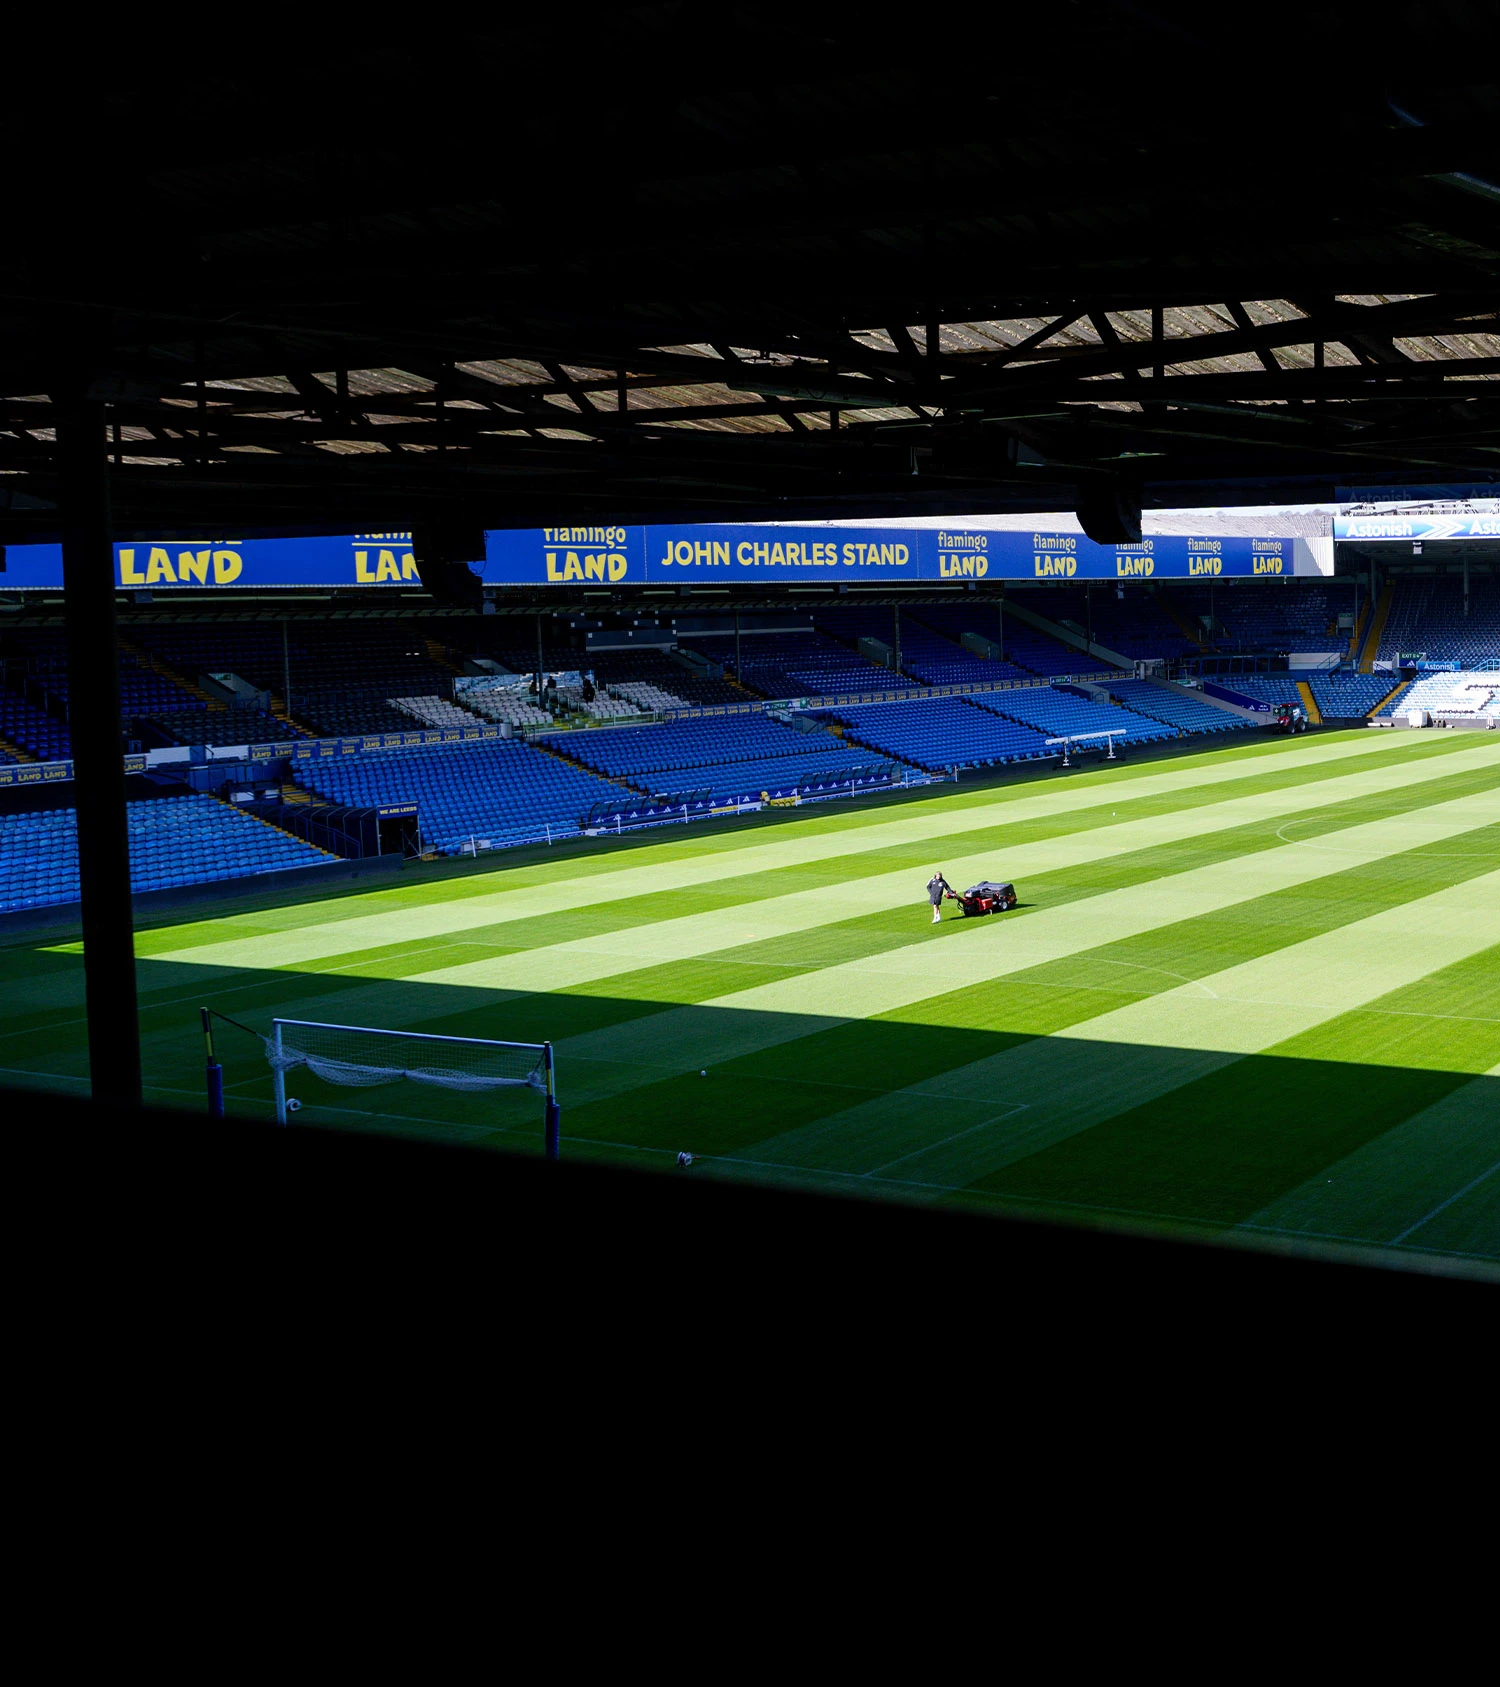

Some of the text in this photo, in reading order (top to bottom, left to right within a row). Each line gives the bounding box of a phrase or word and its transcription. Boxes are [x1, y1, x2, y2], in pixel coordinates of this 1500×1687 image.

[1346, 521, 1413, 537] Astonish
[938, 531, 988, 552] flamingo
[1033, 533, 1076, 554] flamingo
[1188, 537, 1221, 555] flamingo
[1252, 538, 1283, 555] flamingo
[661, 541, 909, 566] JOHN CHARLES STAND
[119, 547, 243, 585] LAND
[355, 549, 421, 583] LAN
[546, 551, 628, 582] LAND
[939, 554, 988, 577] LAND
[1035, 555, 1077, 577] LAND
[1117, 556, 1154, 576] LAND
[1189, 557, 1222, 575] LAND
[1253, 557, 1283, 574] LAND
[1424, 662, 1455, 670] Astonish
[18, 773, 41, 782] LAND
[44, 771, 67, 779] LAND
